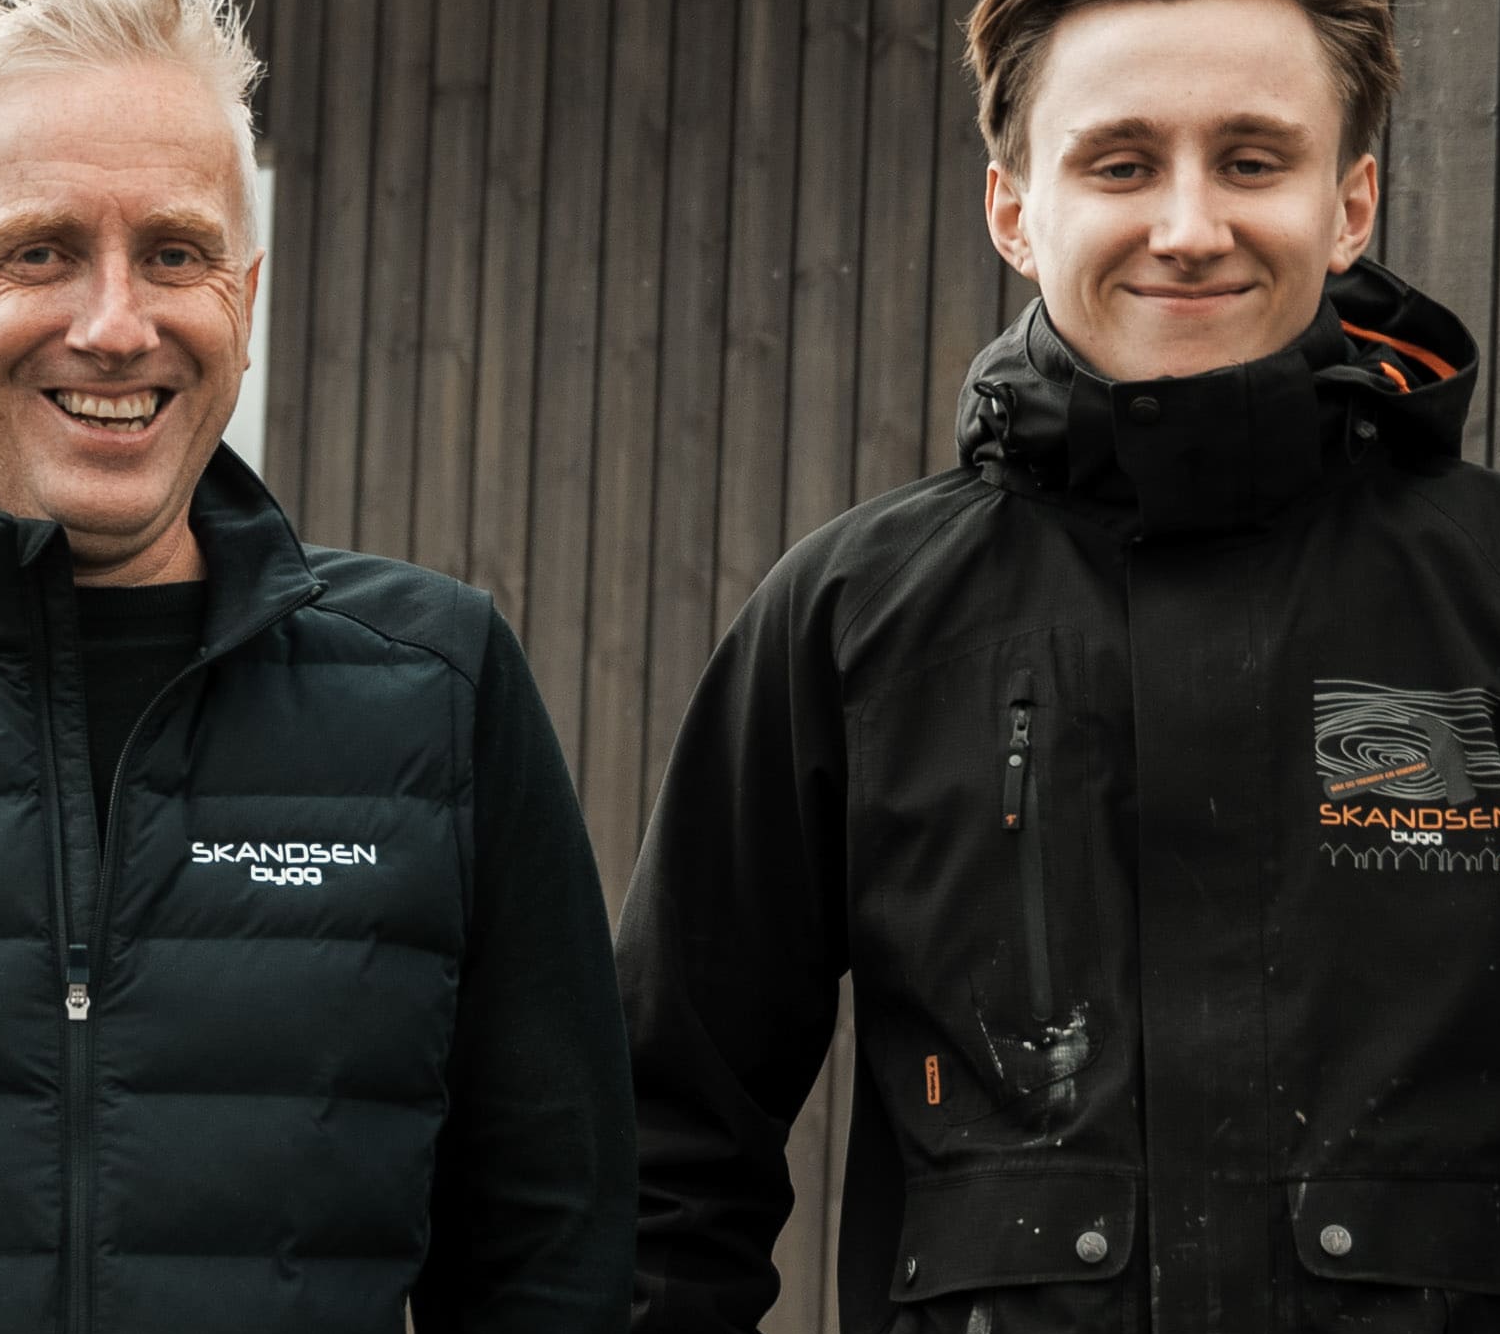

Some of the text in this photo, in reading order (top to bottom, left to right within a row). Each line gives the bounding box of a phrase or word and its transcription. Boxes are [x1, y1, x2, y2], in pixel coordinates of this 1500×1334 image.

[1391, 829, 1443, 845] bygg
[191, 841, 377, 865] SKANDSEN
[250, 864, 323, 886] bygg
